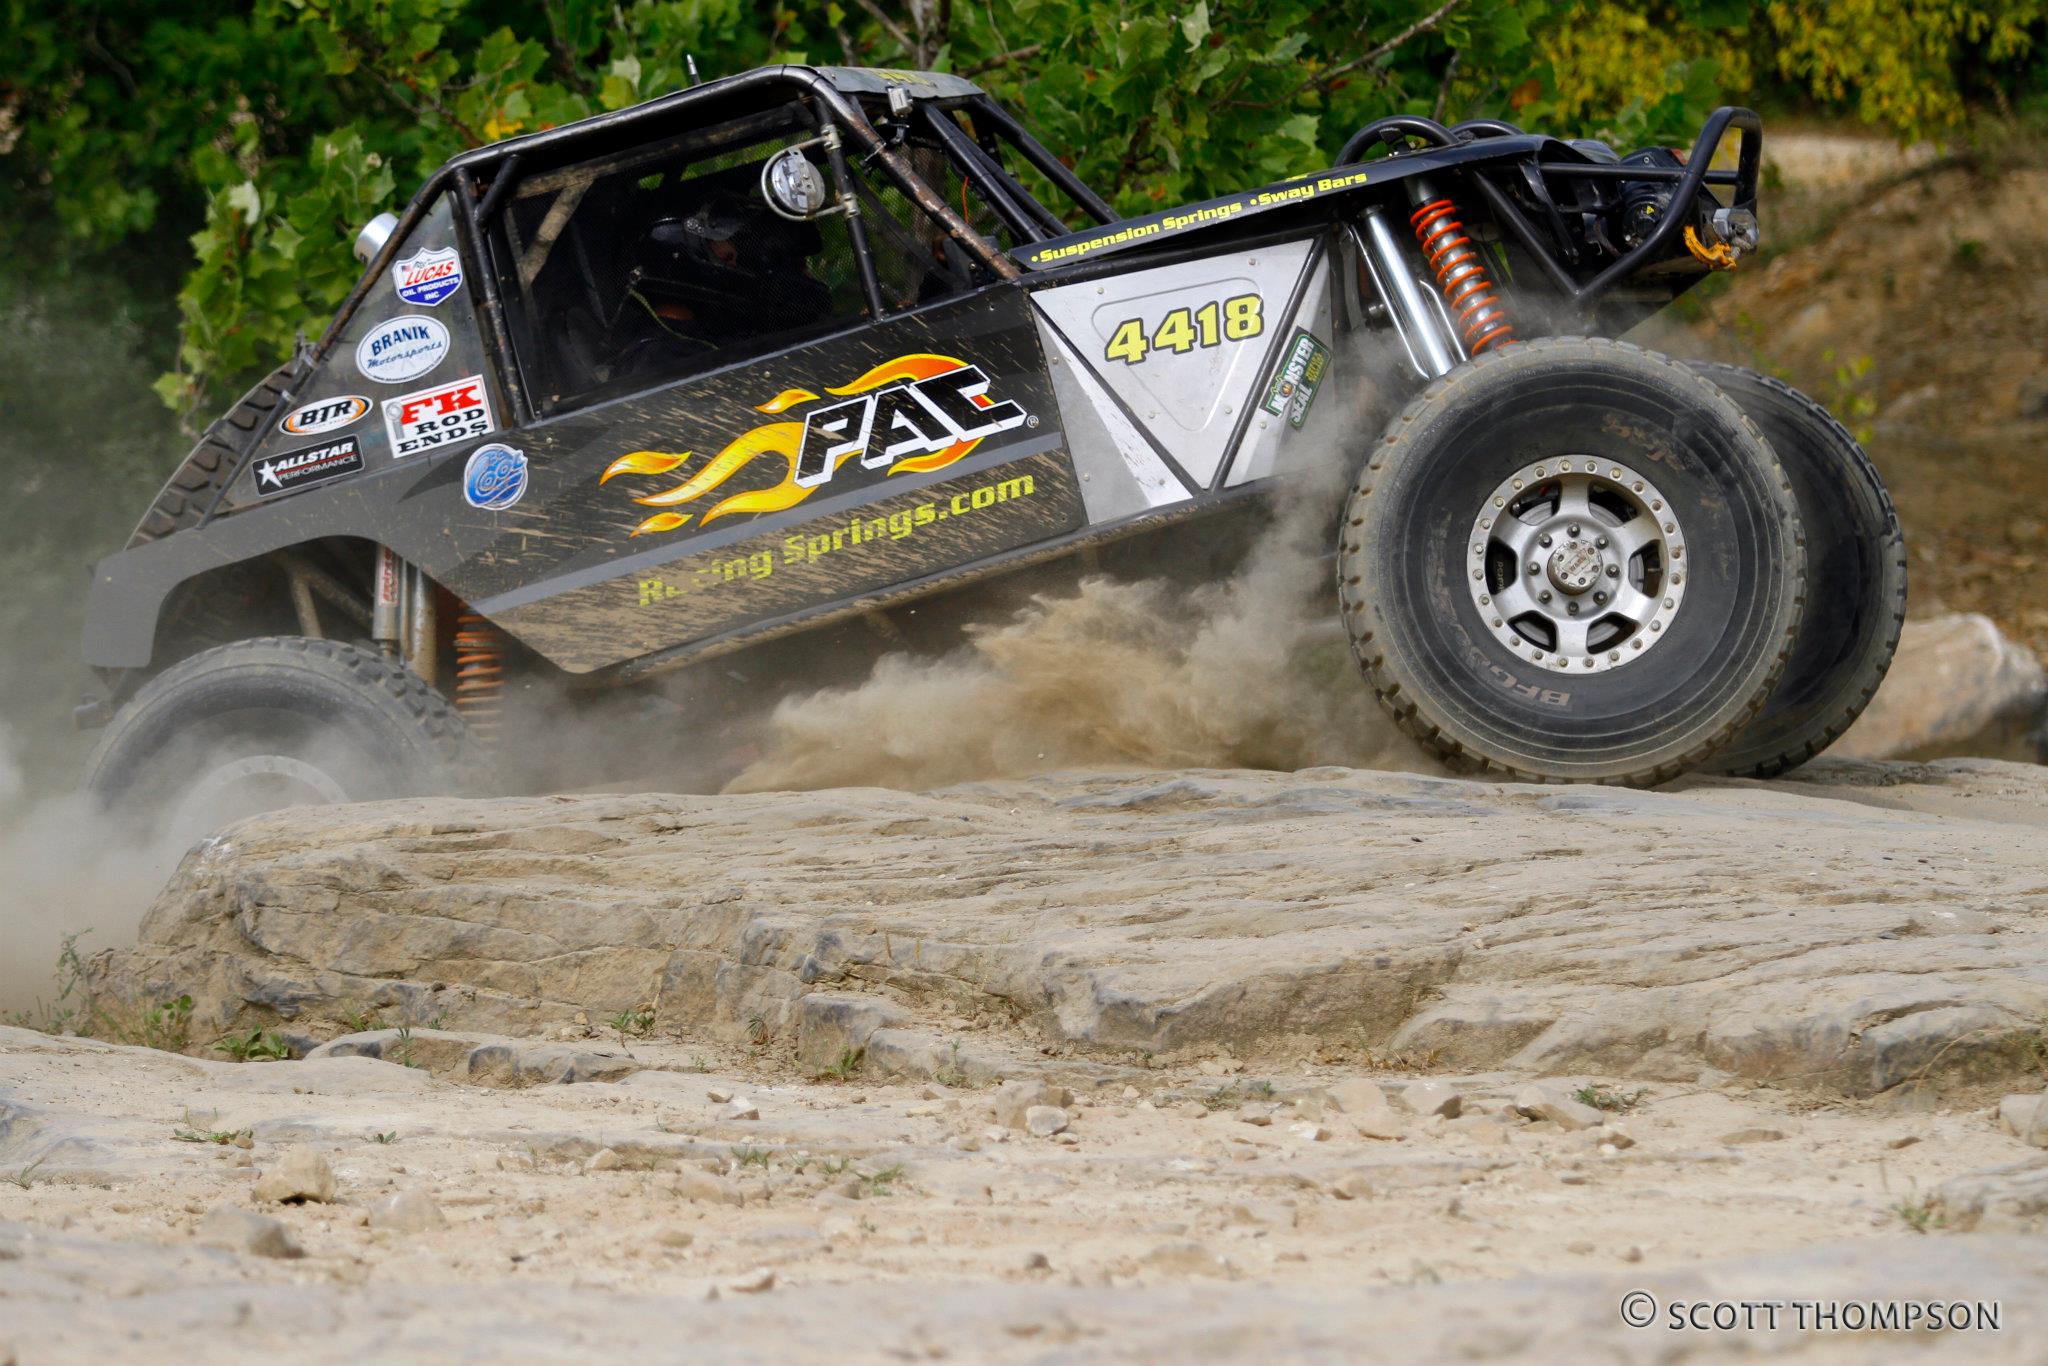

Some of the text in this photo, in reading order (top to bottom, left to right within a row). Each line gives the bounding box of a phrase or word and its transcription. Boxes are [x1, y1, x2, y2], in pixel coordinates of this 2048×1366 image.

[1163, 201, 1243, 232] Springs
[1318, 173, 1367, 193] Bars
[402, 276, 459, 298] OIL PRODUCTS
[405, 261, 454, 286] LUCAS
[371, 326, 430, 356] BRANIK
[1105, 293, 1264, 365] 4418
[367, 341, 442, 369] Motorsports
[299, 400, 353, 427] BTR
[401, 385, 482, 425] FK
[397, 420, 488, 453] ENDS
[415, 408, 485, 435] ROD
[794, 364, 1027, 489] PAC
[275, 442, 354, 472] ALLSTAR
[278, 454, 358, 481] PERFORMANCE
[783, 474, 1035, 565] Springs.com
